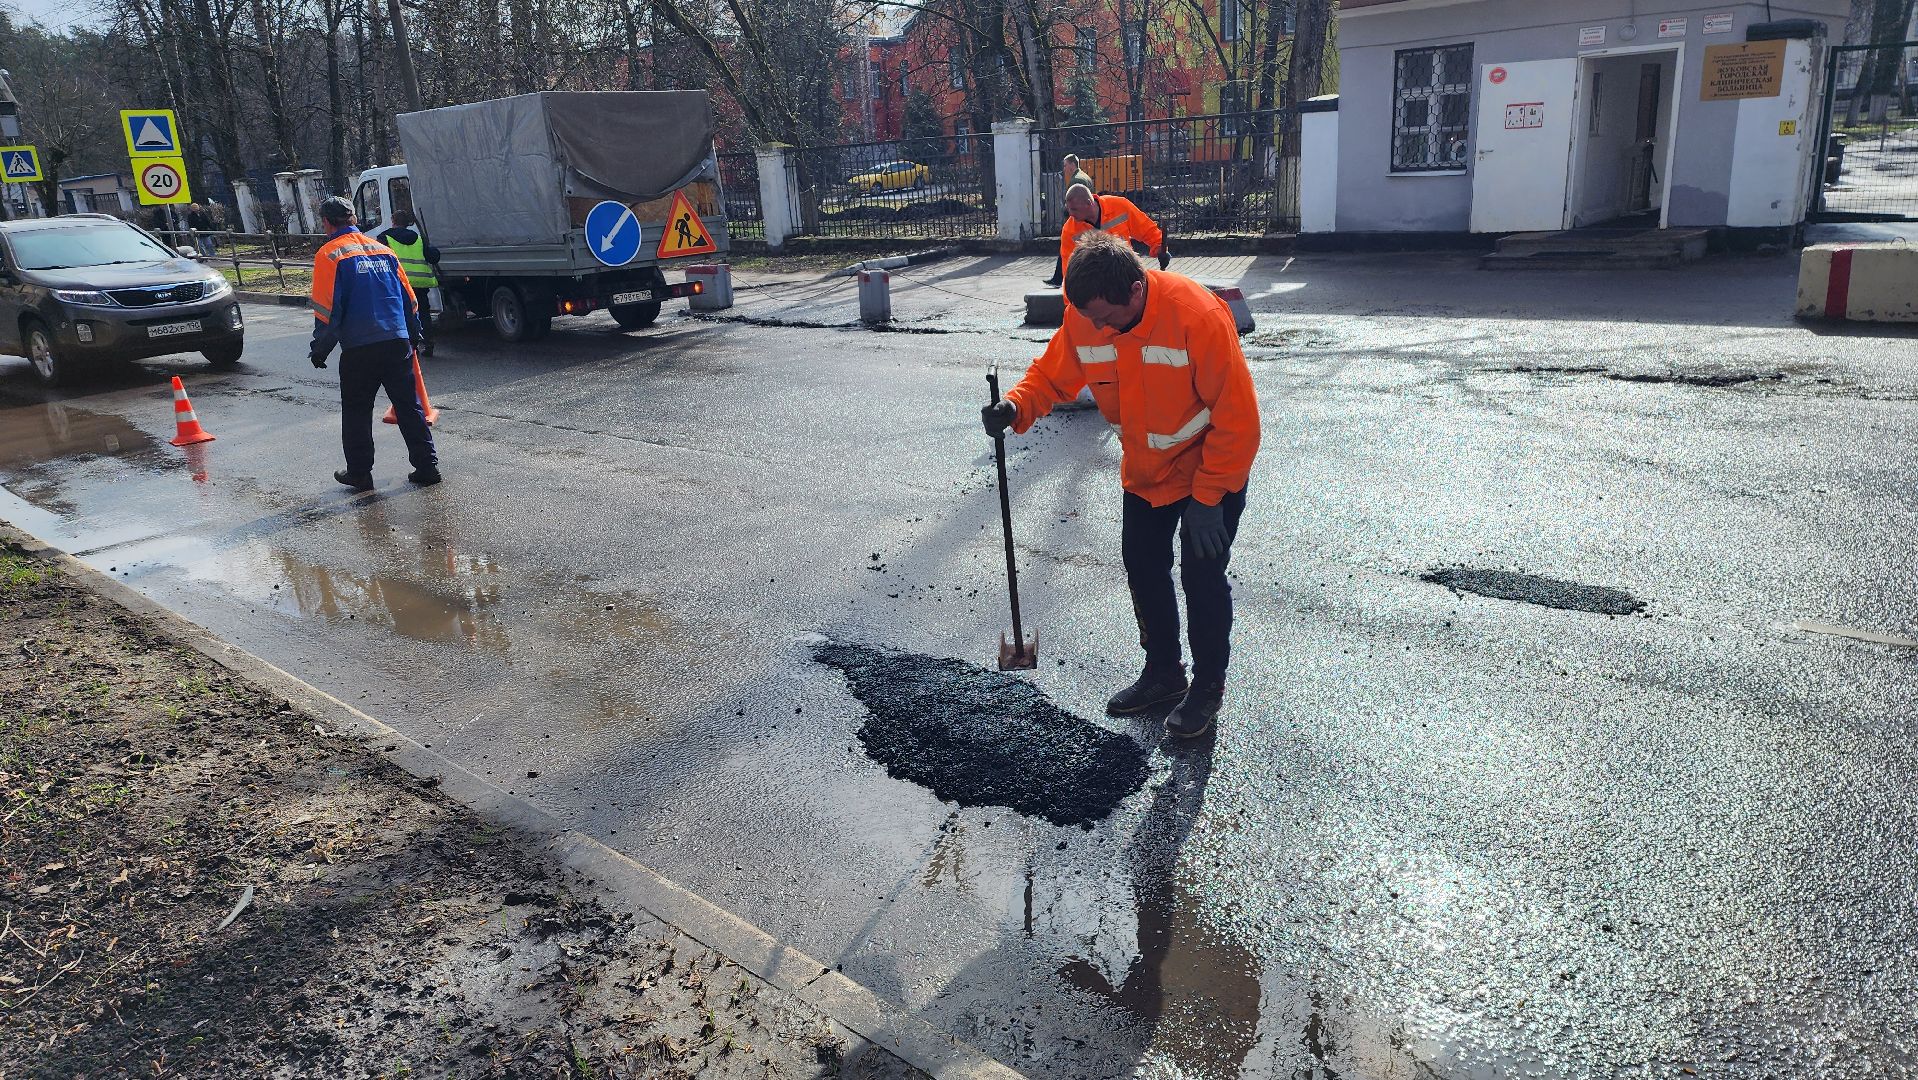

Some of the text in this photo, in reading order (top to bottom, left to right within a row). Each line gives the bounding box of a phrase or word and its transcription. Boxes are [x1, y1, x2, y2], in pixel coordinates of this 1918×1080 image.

[1720, 70, 1768, 79] ГОРОДСКАЯ
[1710, 77, 1772, 86] КЛИНИЧЕСКАЯ
[1717, 84, 1763, 93] БОЛЬНИЦА
[151, 174, 173, 188] 20
